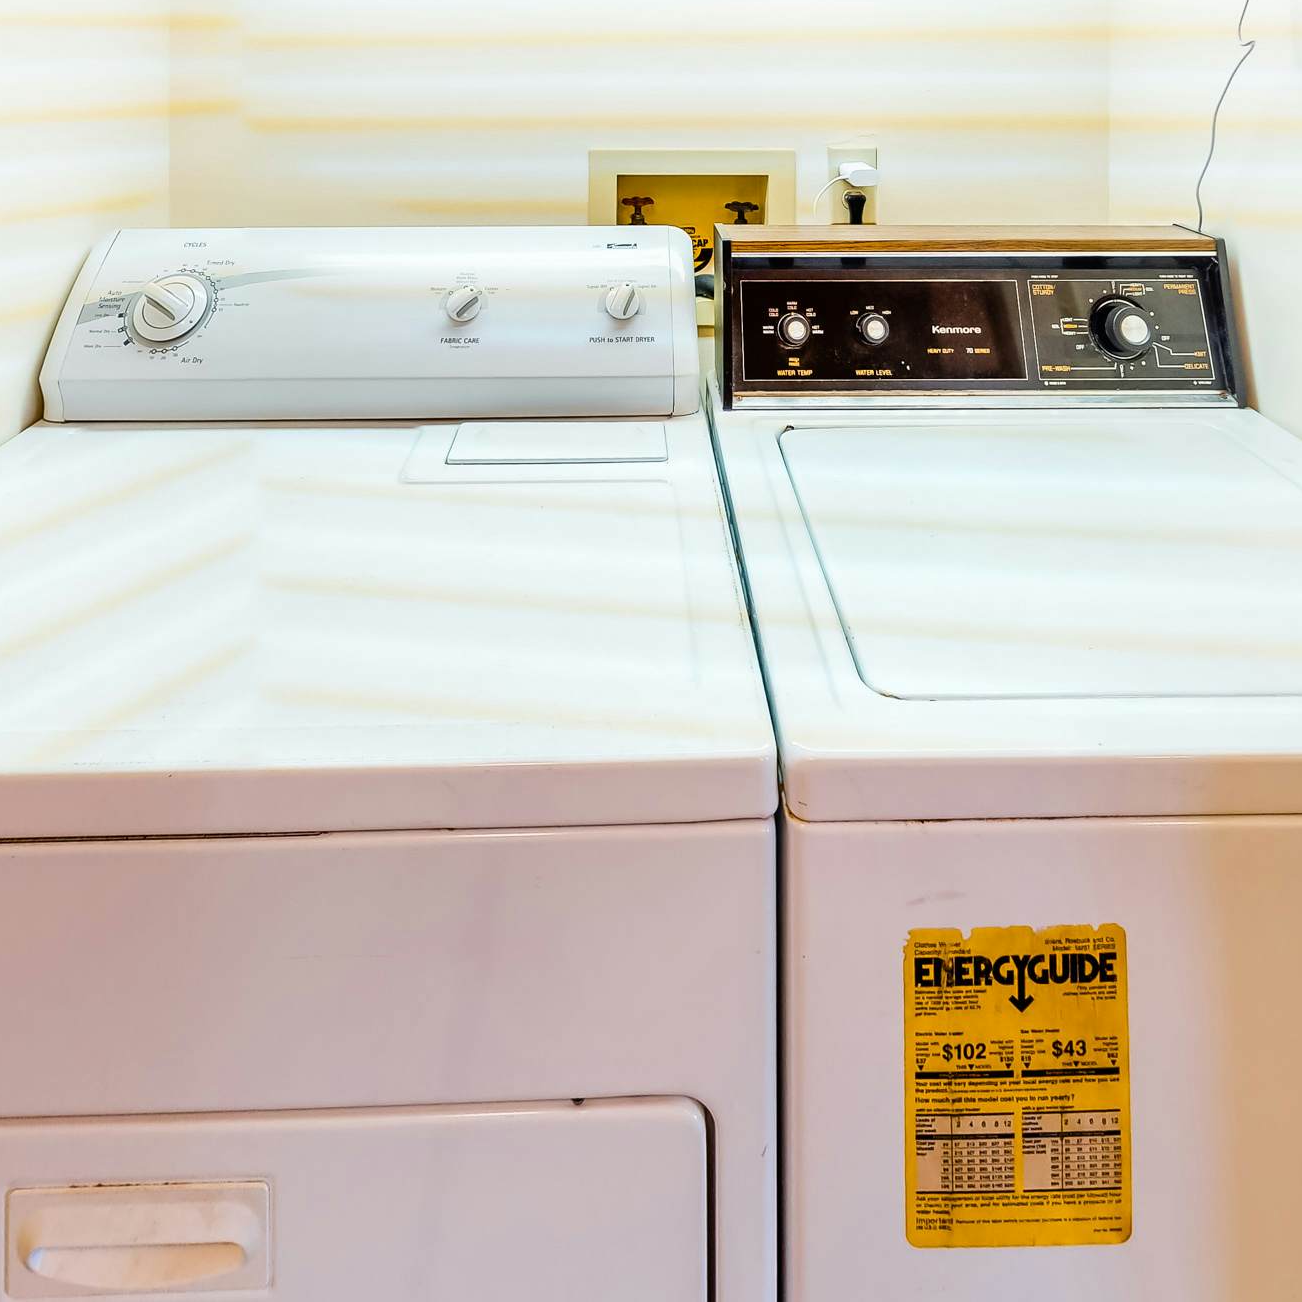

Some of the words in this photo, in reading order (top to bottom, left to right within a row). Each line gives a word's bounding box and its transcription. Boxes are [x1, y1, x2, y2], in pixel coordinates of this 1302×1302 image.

[914, 952, 1117, 988] ENERGYGUIDE
[942, 1043, 986, 1062] $102
[1052, 1040, 1086, 1058] $43
